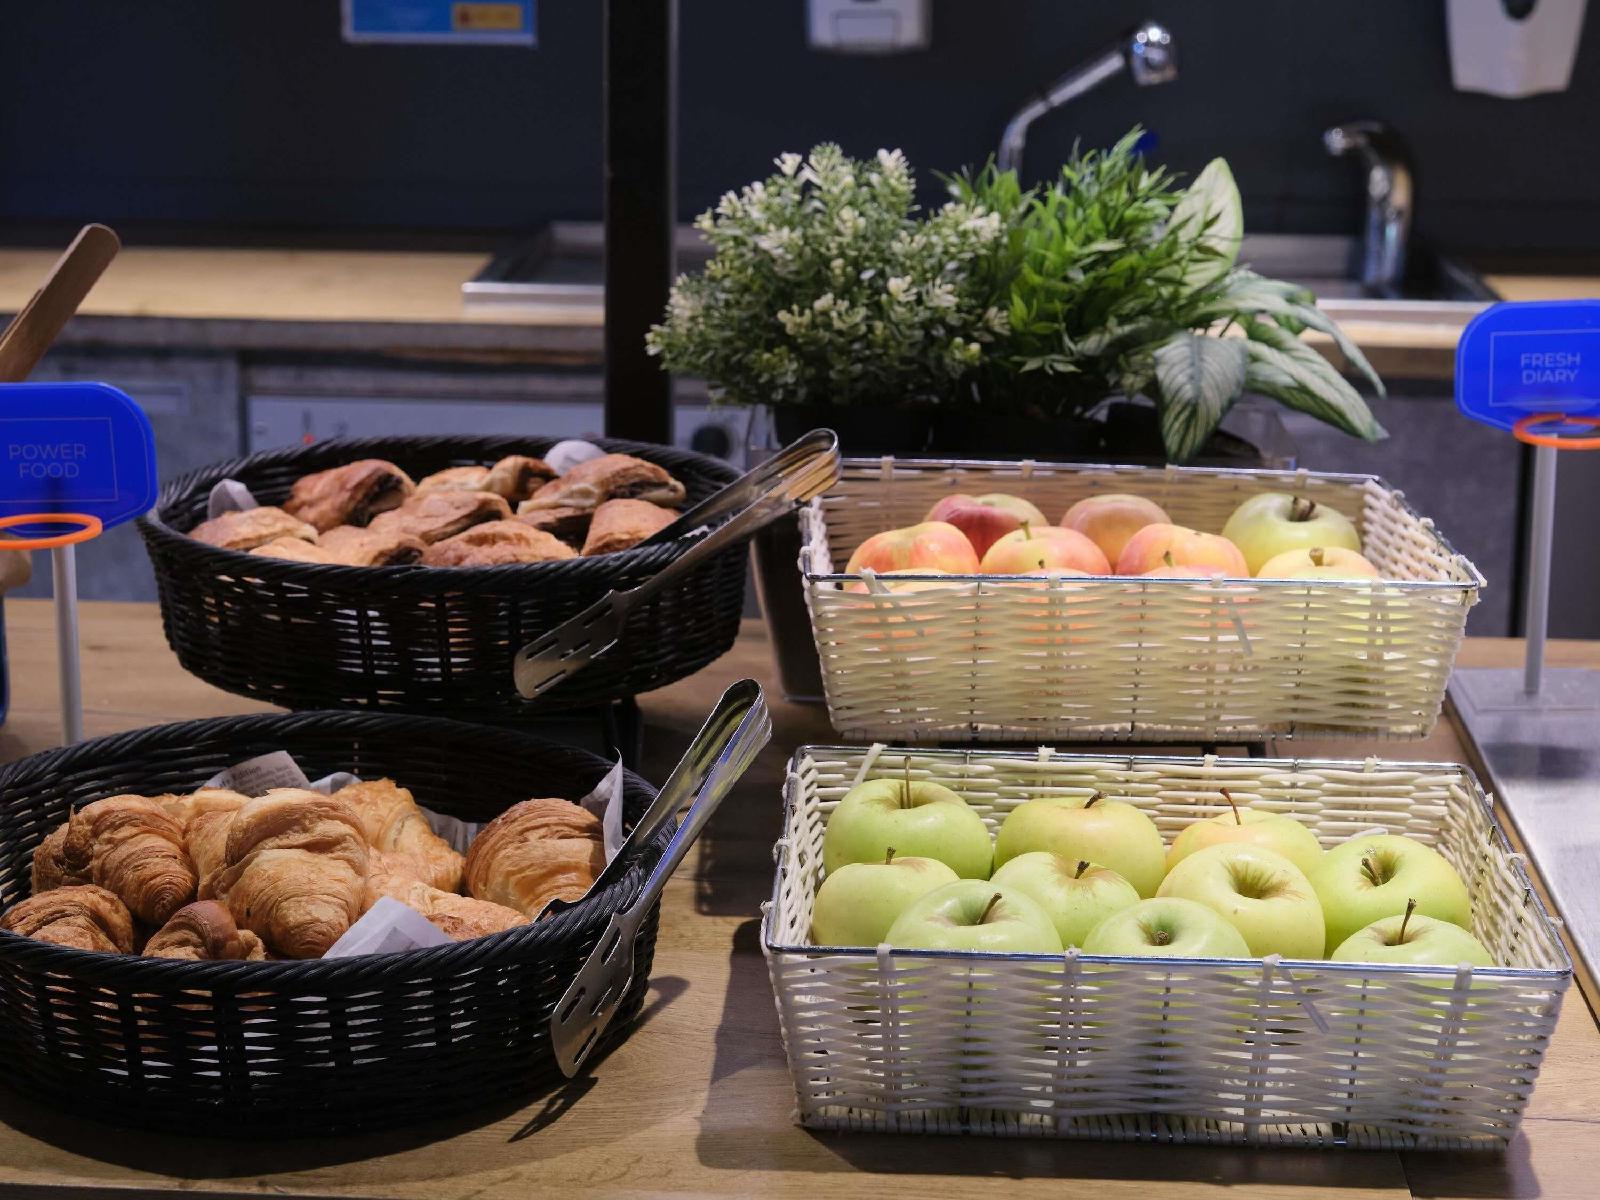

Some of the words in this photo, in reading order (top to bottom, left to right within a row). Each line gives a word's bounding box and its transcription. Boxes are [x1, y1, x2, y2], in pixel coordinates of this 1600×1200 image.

[1521, 352, 1581, 368] FRESH
[1522, 368, 1579, 385] DIARY
[8, 444, 87, 460] POWER
[19, 462, 80, 478] FOOD
